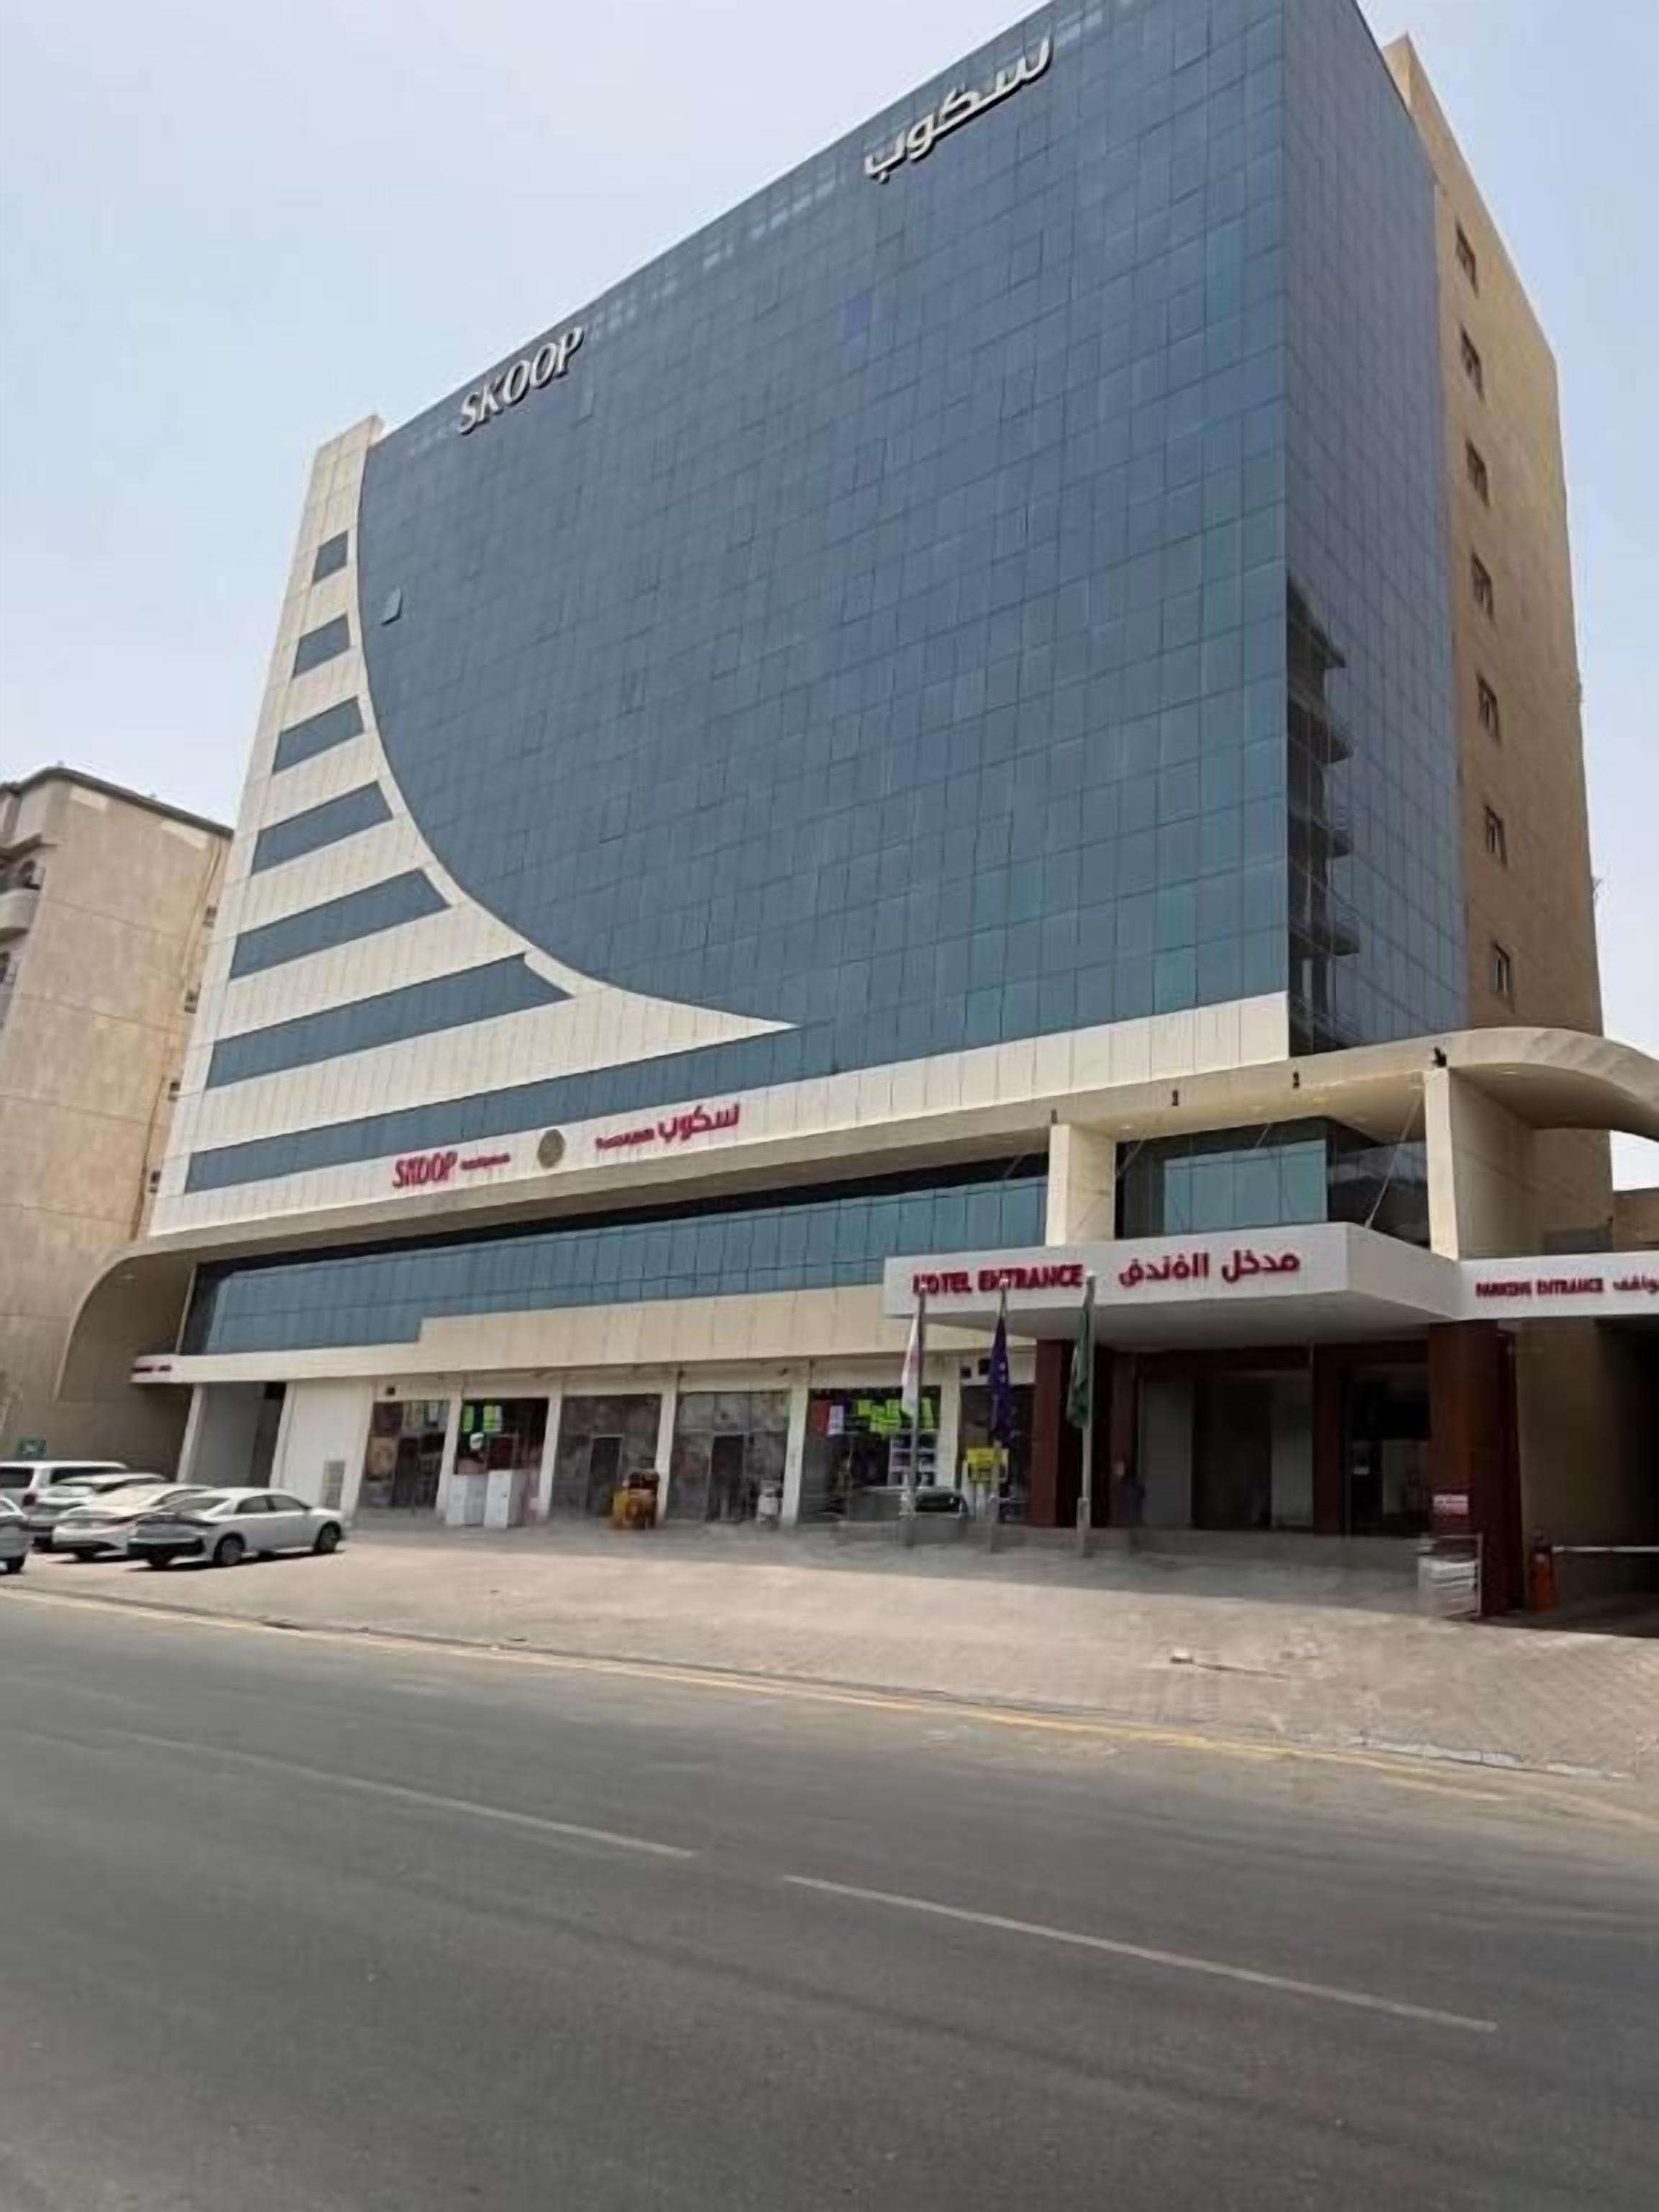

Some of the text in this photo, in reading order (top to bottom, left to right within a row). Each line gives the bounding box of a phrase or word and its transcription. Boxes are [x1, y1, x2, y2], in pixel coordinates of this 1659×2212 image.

[864, 30, 1054, 184] سكوب
[458, 325, 585, 436] SKOOP
[658, 1103, 740, 1143] سكوب
[912, 1263, 1084, 1295] HOTEL ENTRANCE
[1221, 1248, 1301, 1284] مدخل
